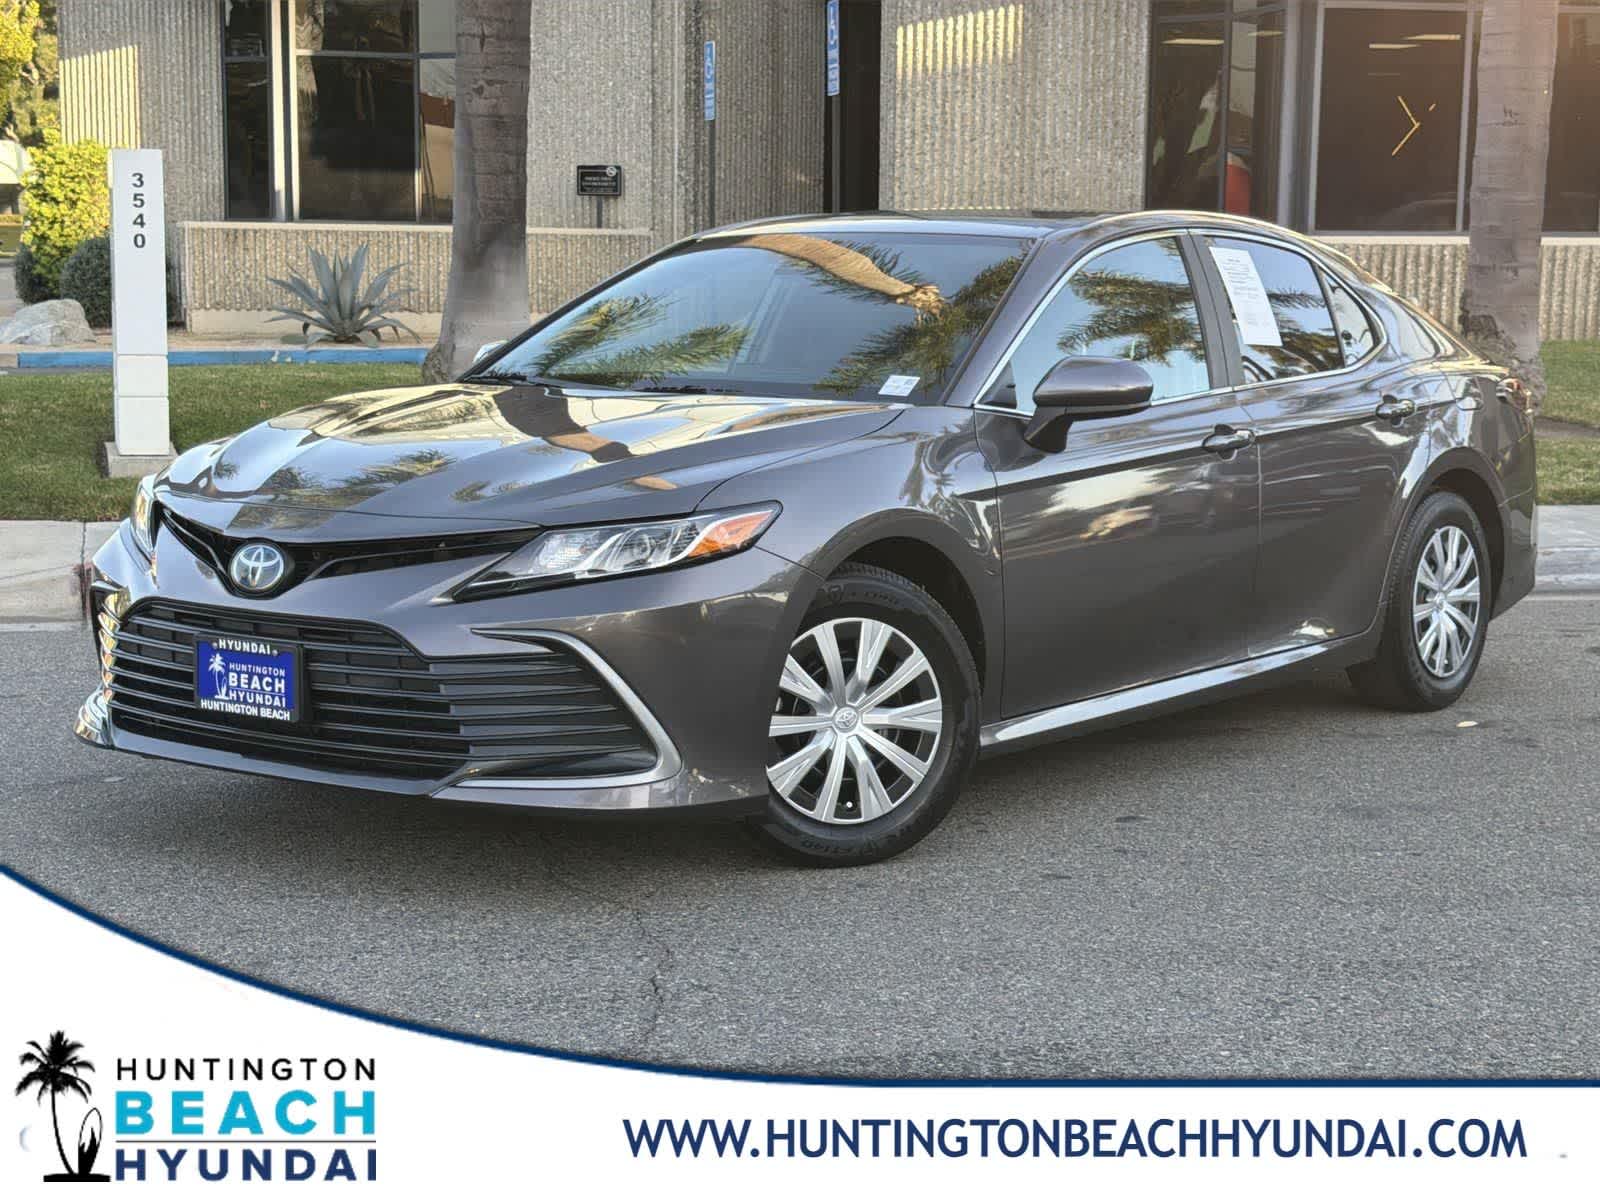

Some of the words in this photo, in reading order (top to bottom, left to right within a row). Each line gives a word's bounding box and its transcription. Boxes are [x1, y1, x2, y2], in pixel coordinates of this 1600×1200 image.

[132, 172, 146, 248] 3540
[219, 639, 271, 655] HYUNDAI
[229, 663, 286, 677] HUNTINGTON
[228, 672, 285, 693] BEACH
[229, 690, 286, 707] HYUNDAI
[200, 698, 258, 716] HUNTINGTON
[260, 707, 290, 721] BEACH
